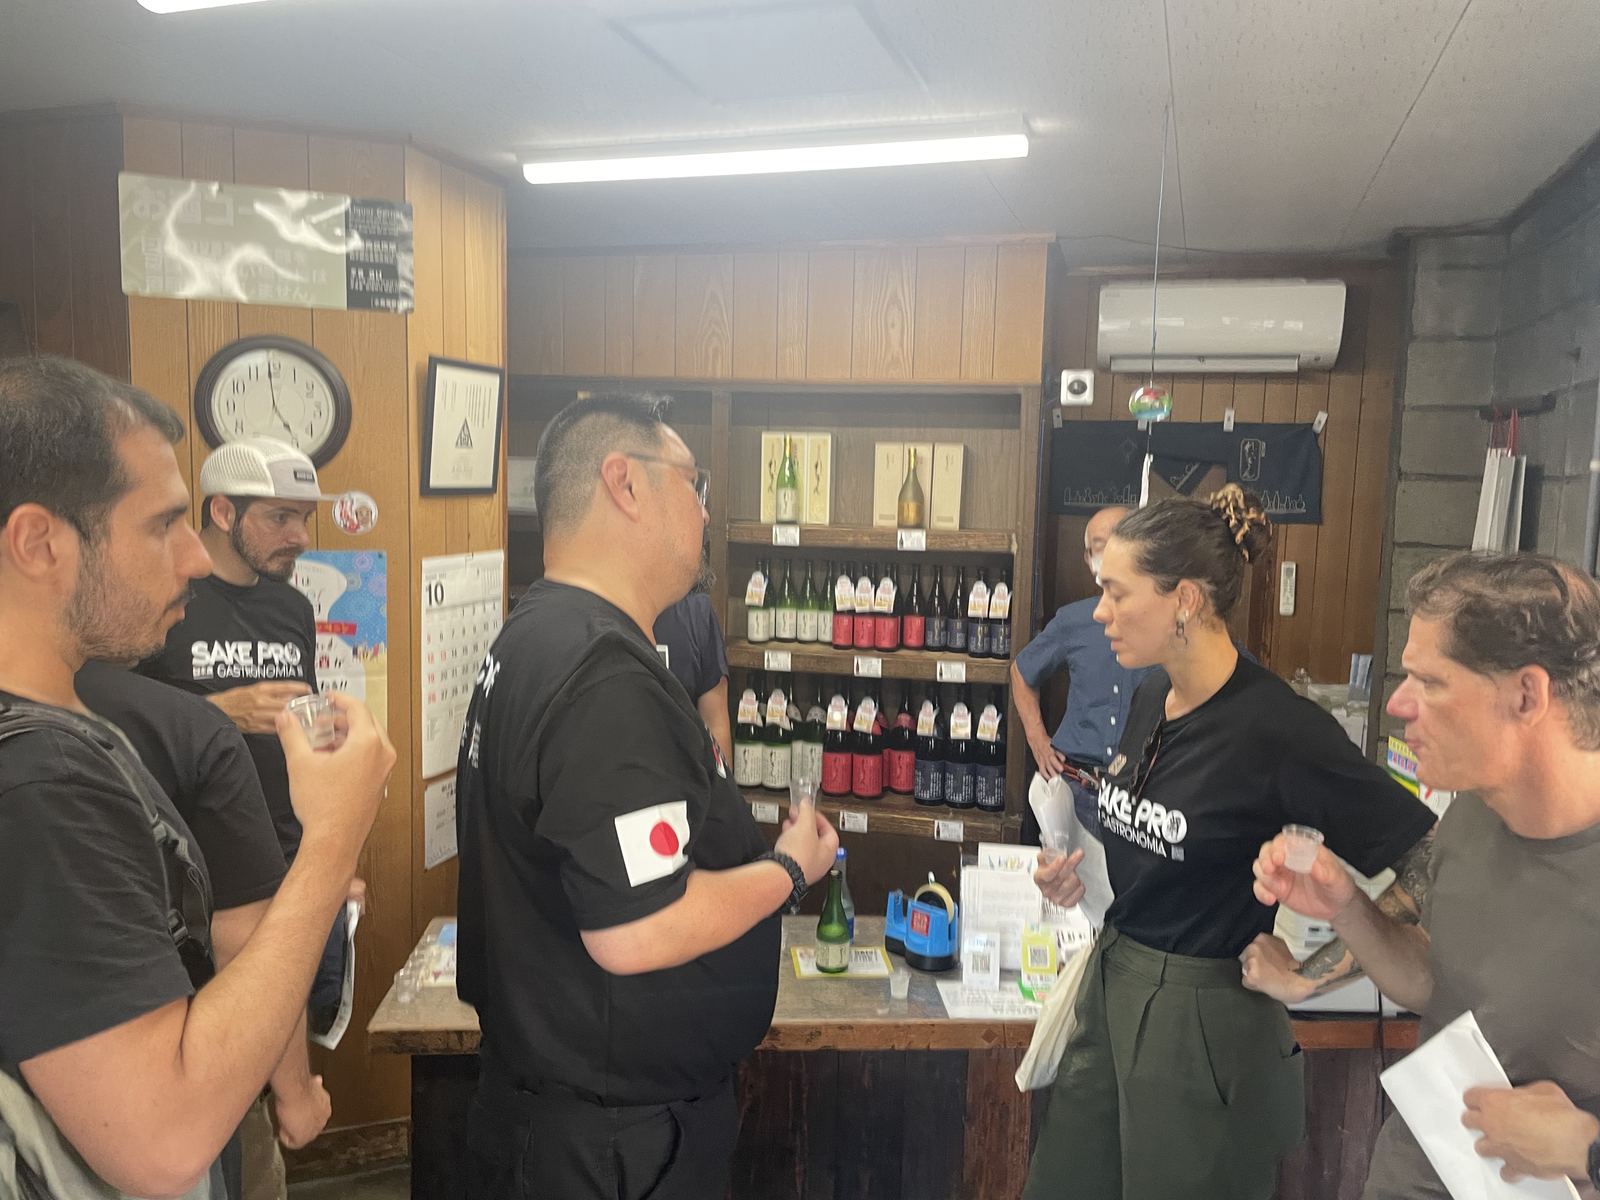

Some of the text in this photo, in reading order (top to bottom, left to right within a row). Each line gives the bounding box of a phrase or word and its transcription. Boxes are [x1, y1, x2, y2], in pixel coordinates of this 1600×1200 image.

[249, 364, 259, 381] 11
[232, 379, 245, 395] 10
[226, 400, 236, 415] 9
[426, 582, 445, 606] 10
[191, 640, 254, 667] SAKE
[257, 640, 301, 667] PRO
[216, 663, 297, 679] GASTRONOMIA
[1134, 798, 1188, 844] PRO
[1101, 810, 1167, 858] GASTRONOMIA
